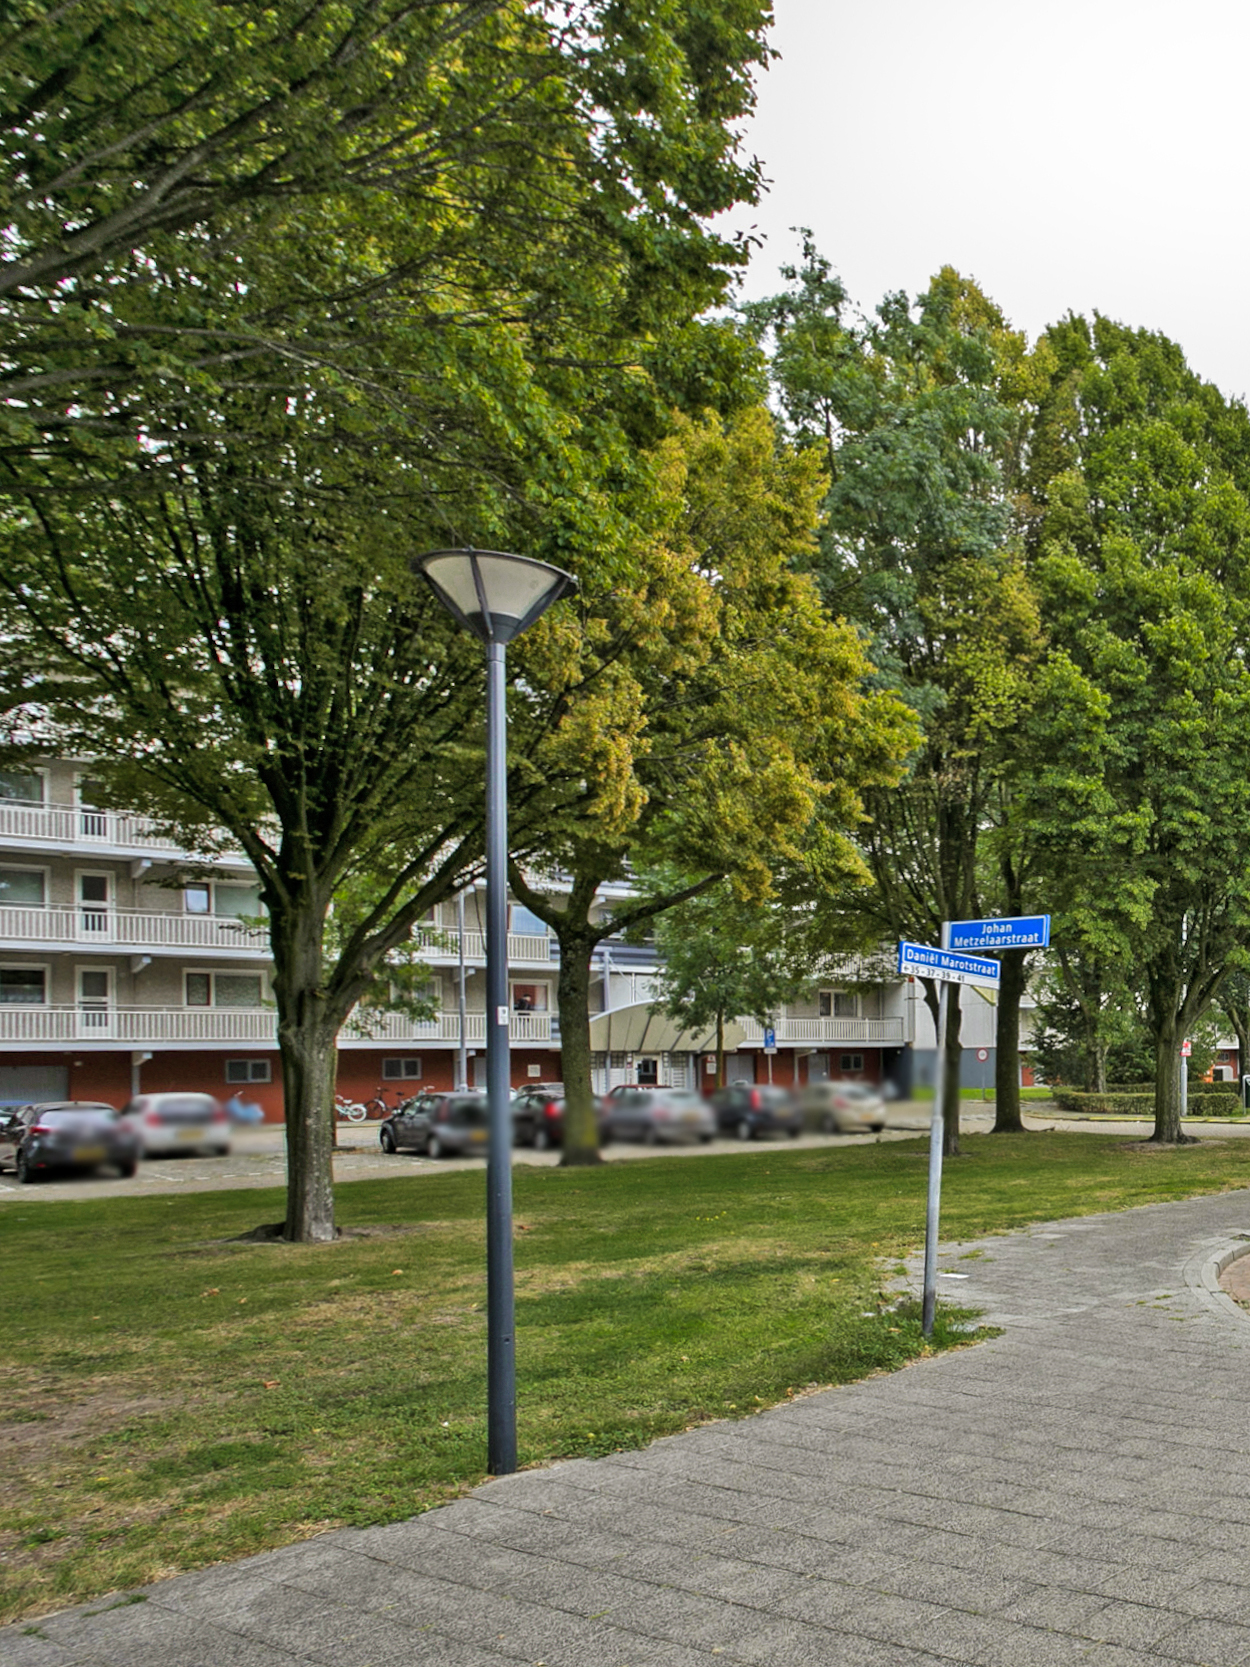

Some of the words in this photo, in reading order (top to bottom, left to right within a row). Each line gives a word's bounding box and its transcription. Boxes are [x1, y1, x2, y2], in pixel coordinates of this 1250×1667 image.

[982, 923, 1012, 934] Johan
[954, 933, 1039, 947] Metzelaarstraat
[907, 948, 938, 964] Daniël
[941, 955, 996, 976] Marotstraat
[911, 965, 920, 974] 35
[927, 968, 935, 976] 37
[957, 974, 965, 982] 41
